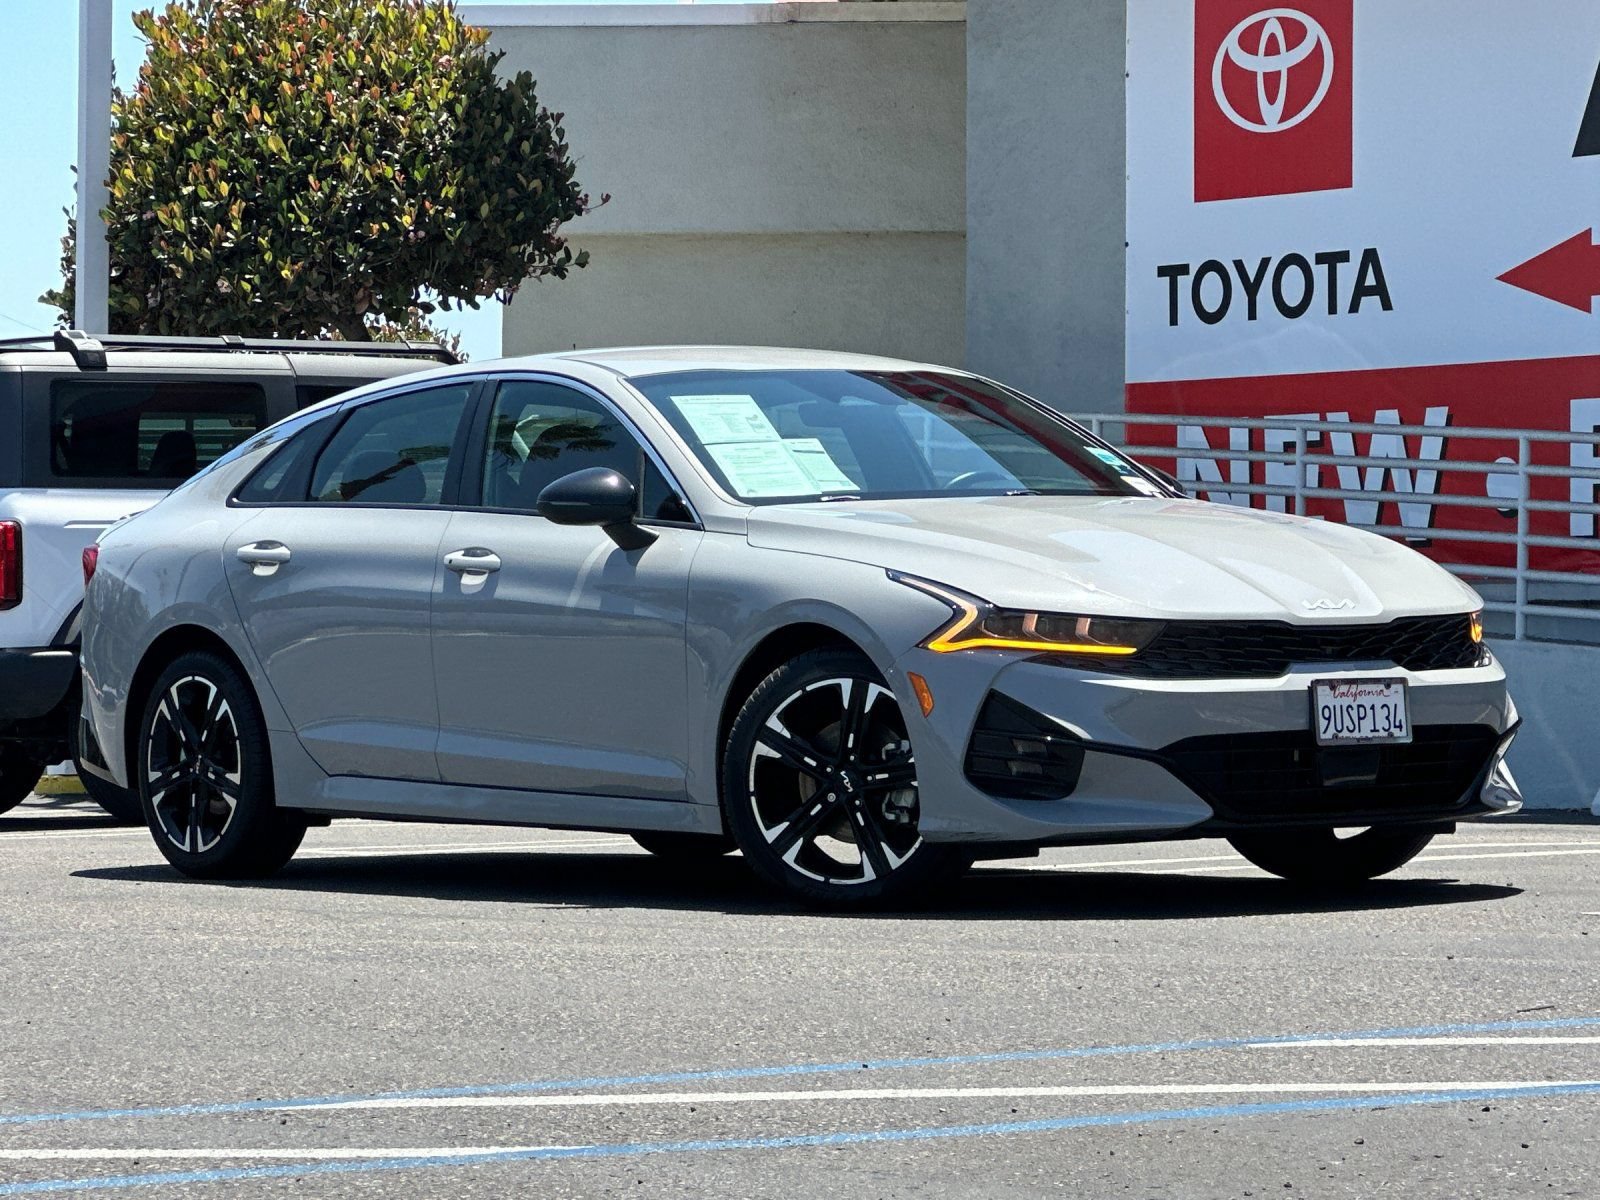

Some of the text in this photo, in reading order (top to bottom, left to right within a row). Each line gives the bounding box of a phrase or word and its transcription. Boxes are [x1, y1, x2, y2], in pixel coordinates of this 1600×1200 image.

[1157, 247, 1393, 326] TOYOTA
[1176, 406, 1450, 541] NEW
[1321, 703, 1403, 734] 9USP134
[1332, 684, 1390, 702] California
